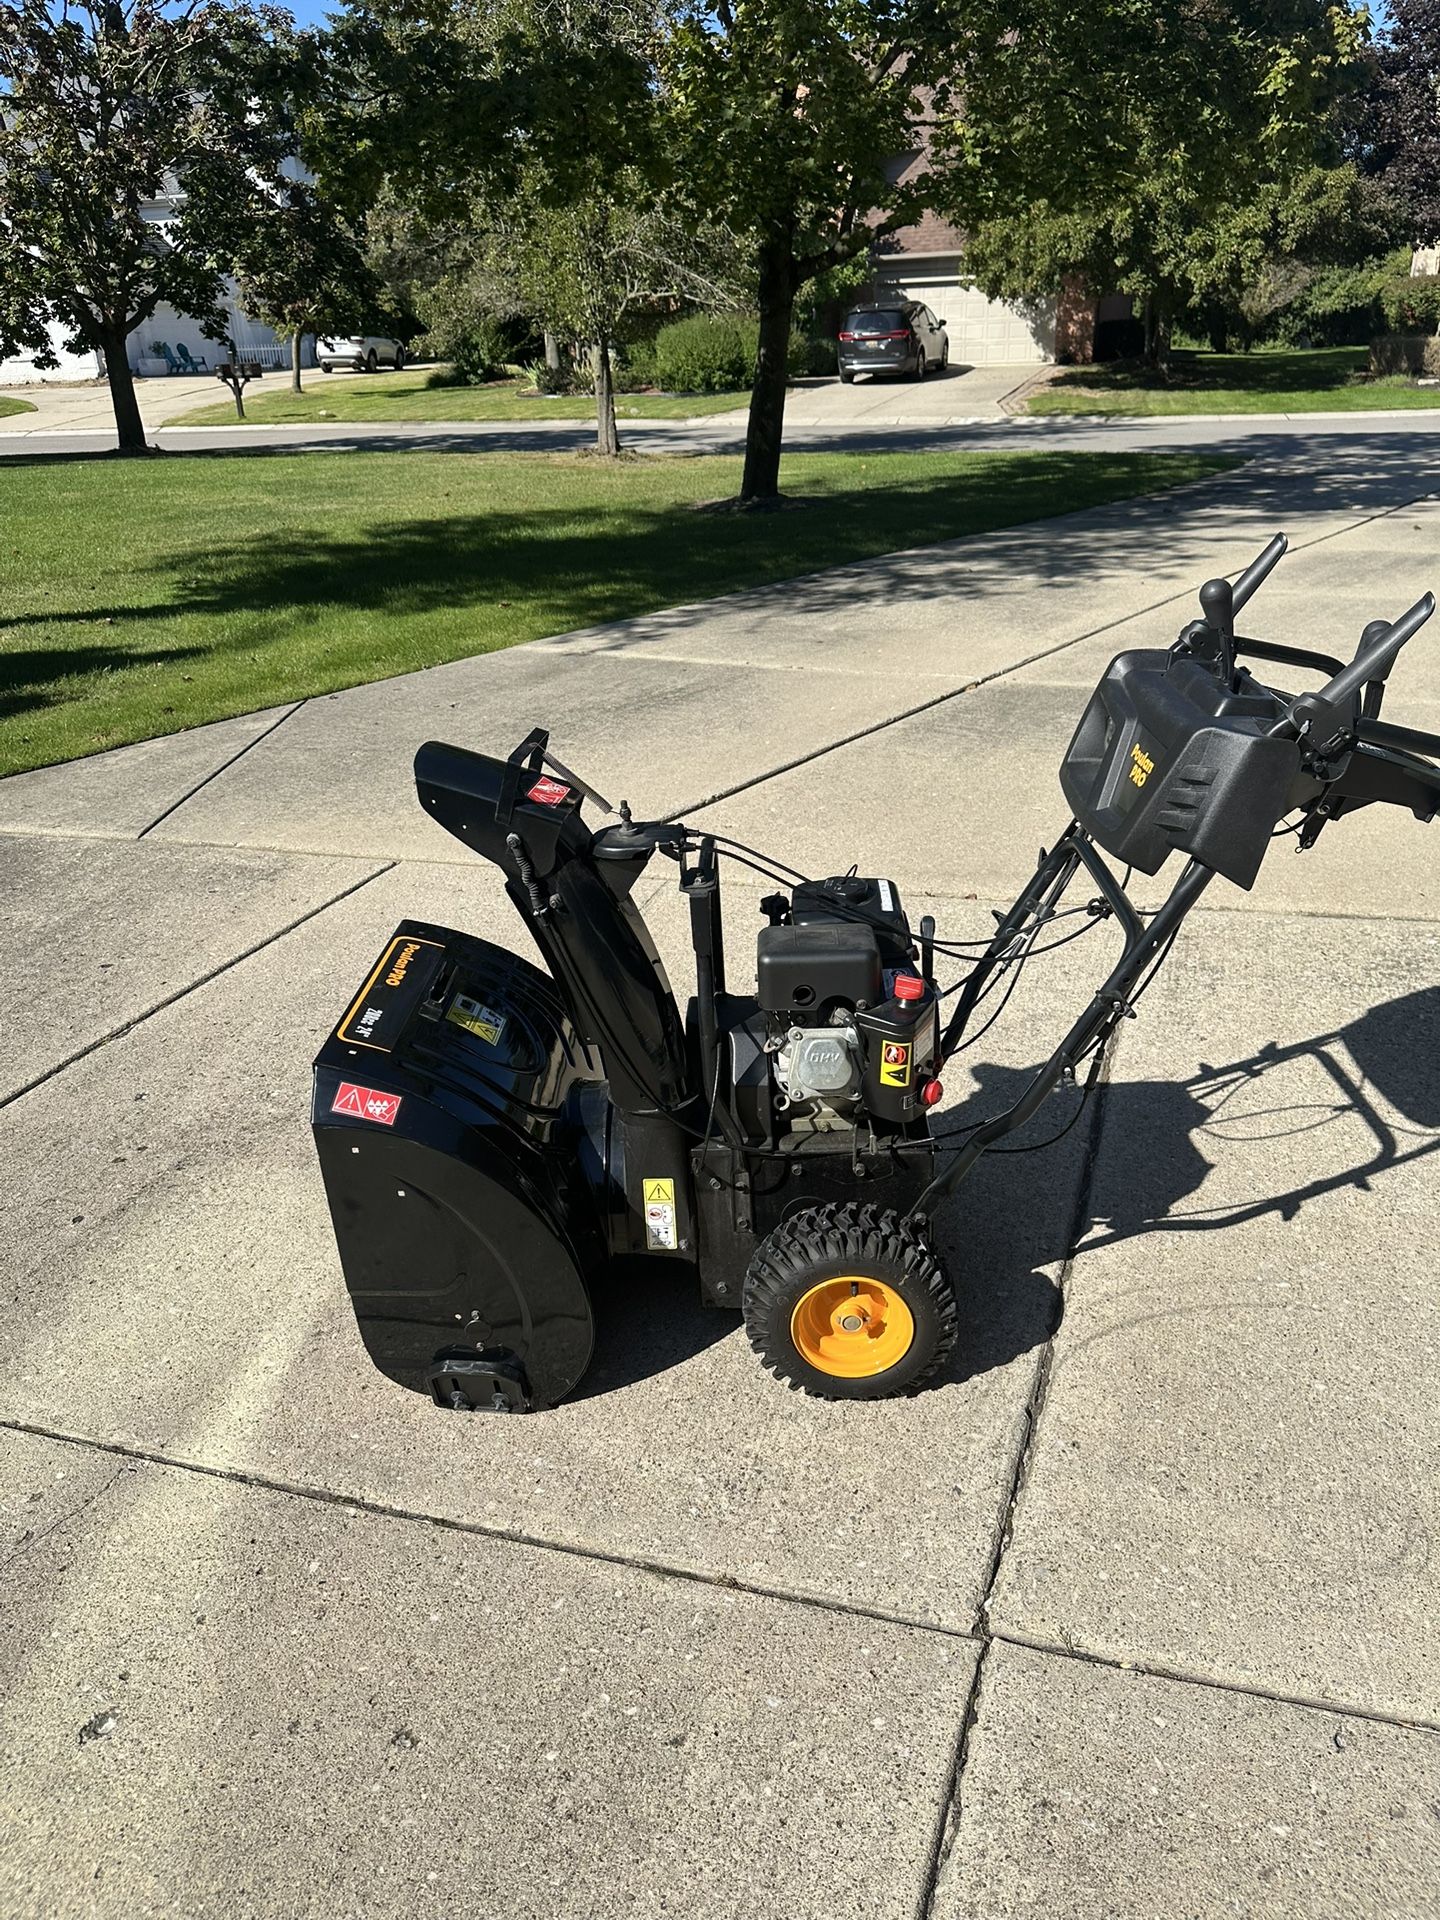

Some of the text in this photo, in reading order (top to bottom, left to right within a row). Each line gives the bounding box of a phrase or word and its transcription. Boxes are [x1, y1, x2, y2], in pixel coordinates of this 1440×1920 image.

[1130, 742, 1155, 774] Poulan
[1129, 763, 1147, 787] PRO
[385, 943, 421, 986] Poulan PRO
